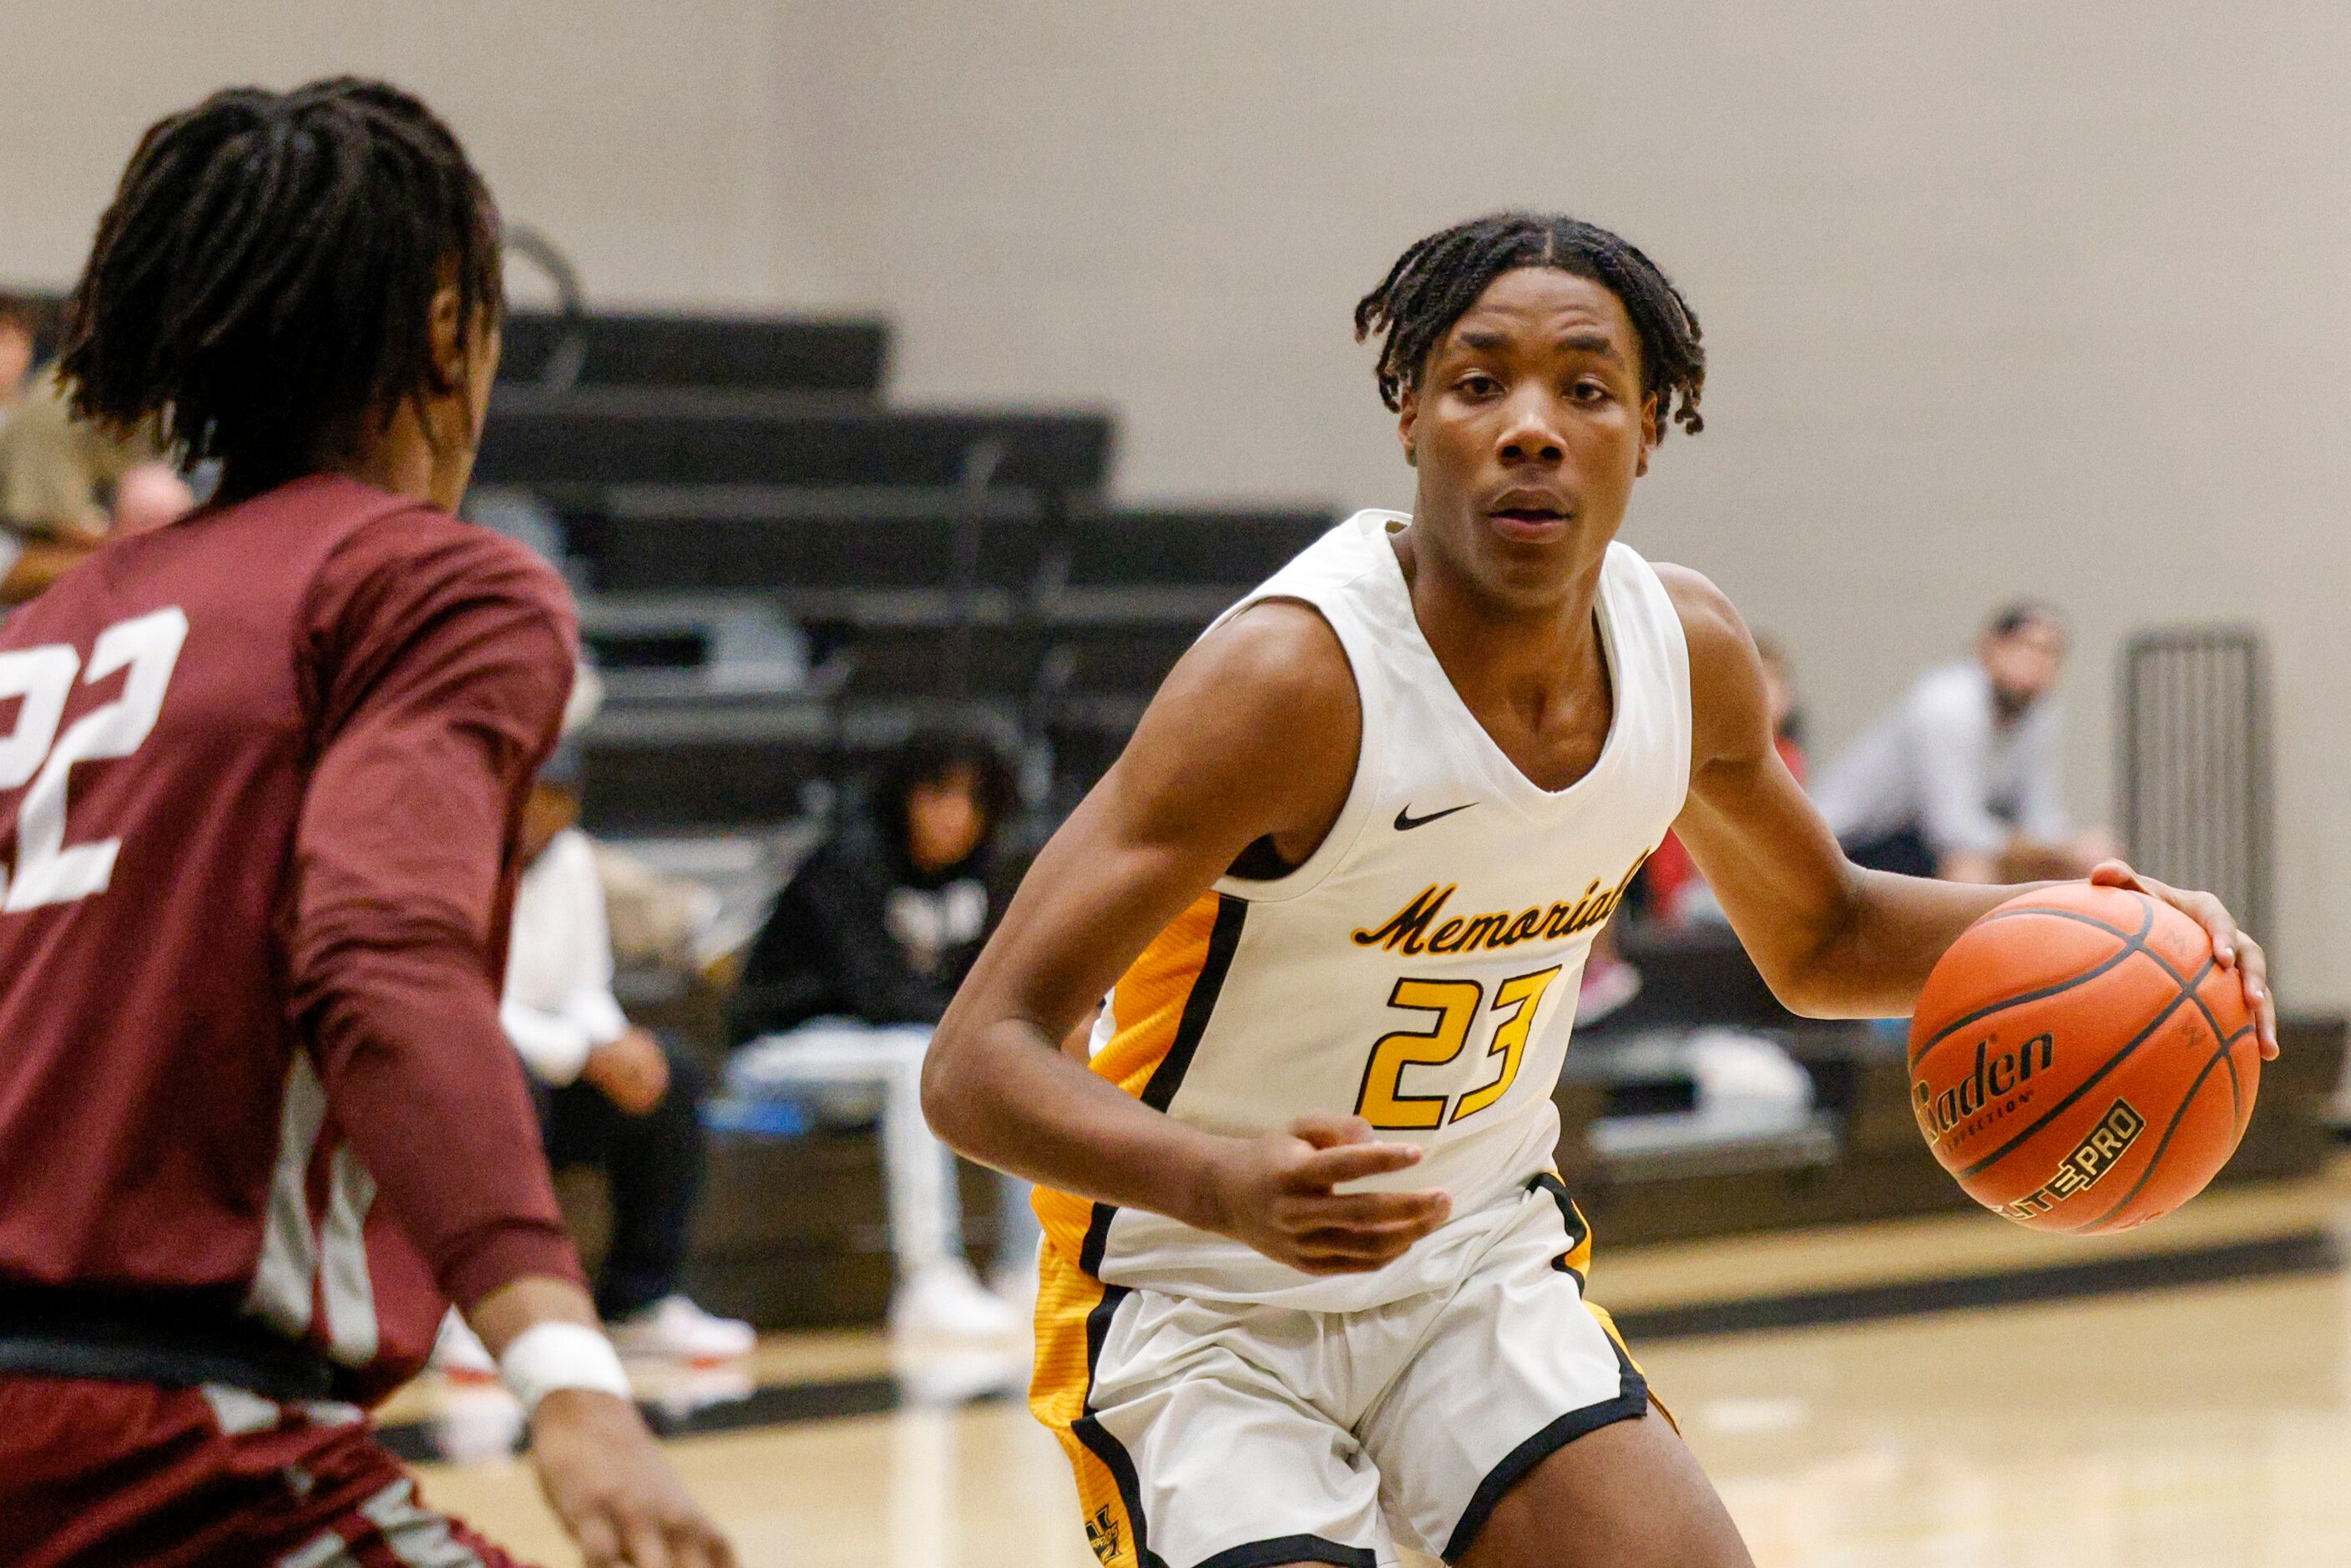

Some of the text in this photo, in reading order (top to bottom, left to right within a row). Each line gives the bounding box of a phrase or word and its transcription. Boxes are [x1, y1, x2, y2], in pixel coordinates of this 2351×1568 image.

[1351, 845, 1651, 957] Memorial
[1352, 964, 1563, 1130] 23
[1990, 1107, 2137, 1221] LITE PRO
